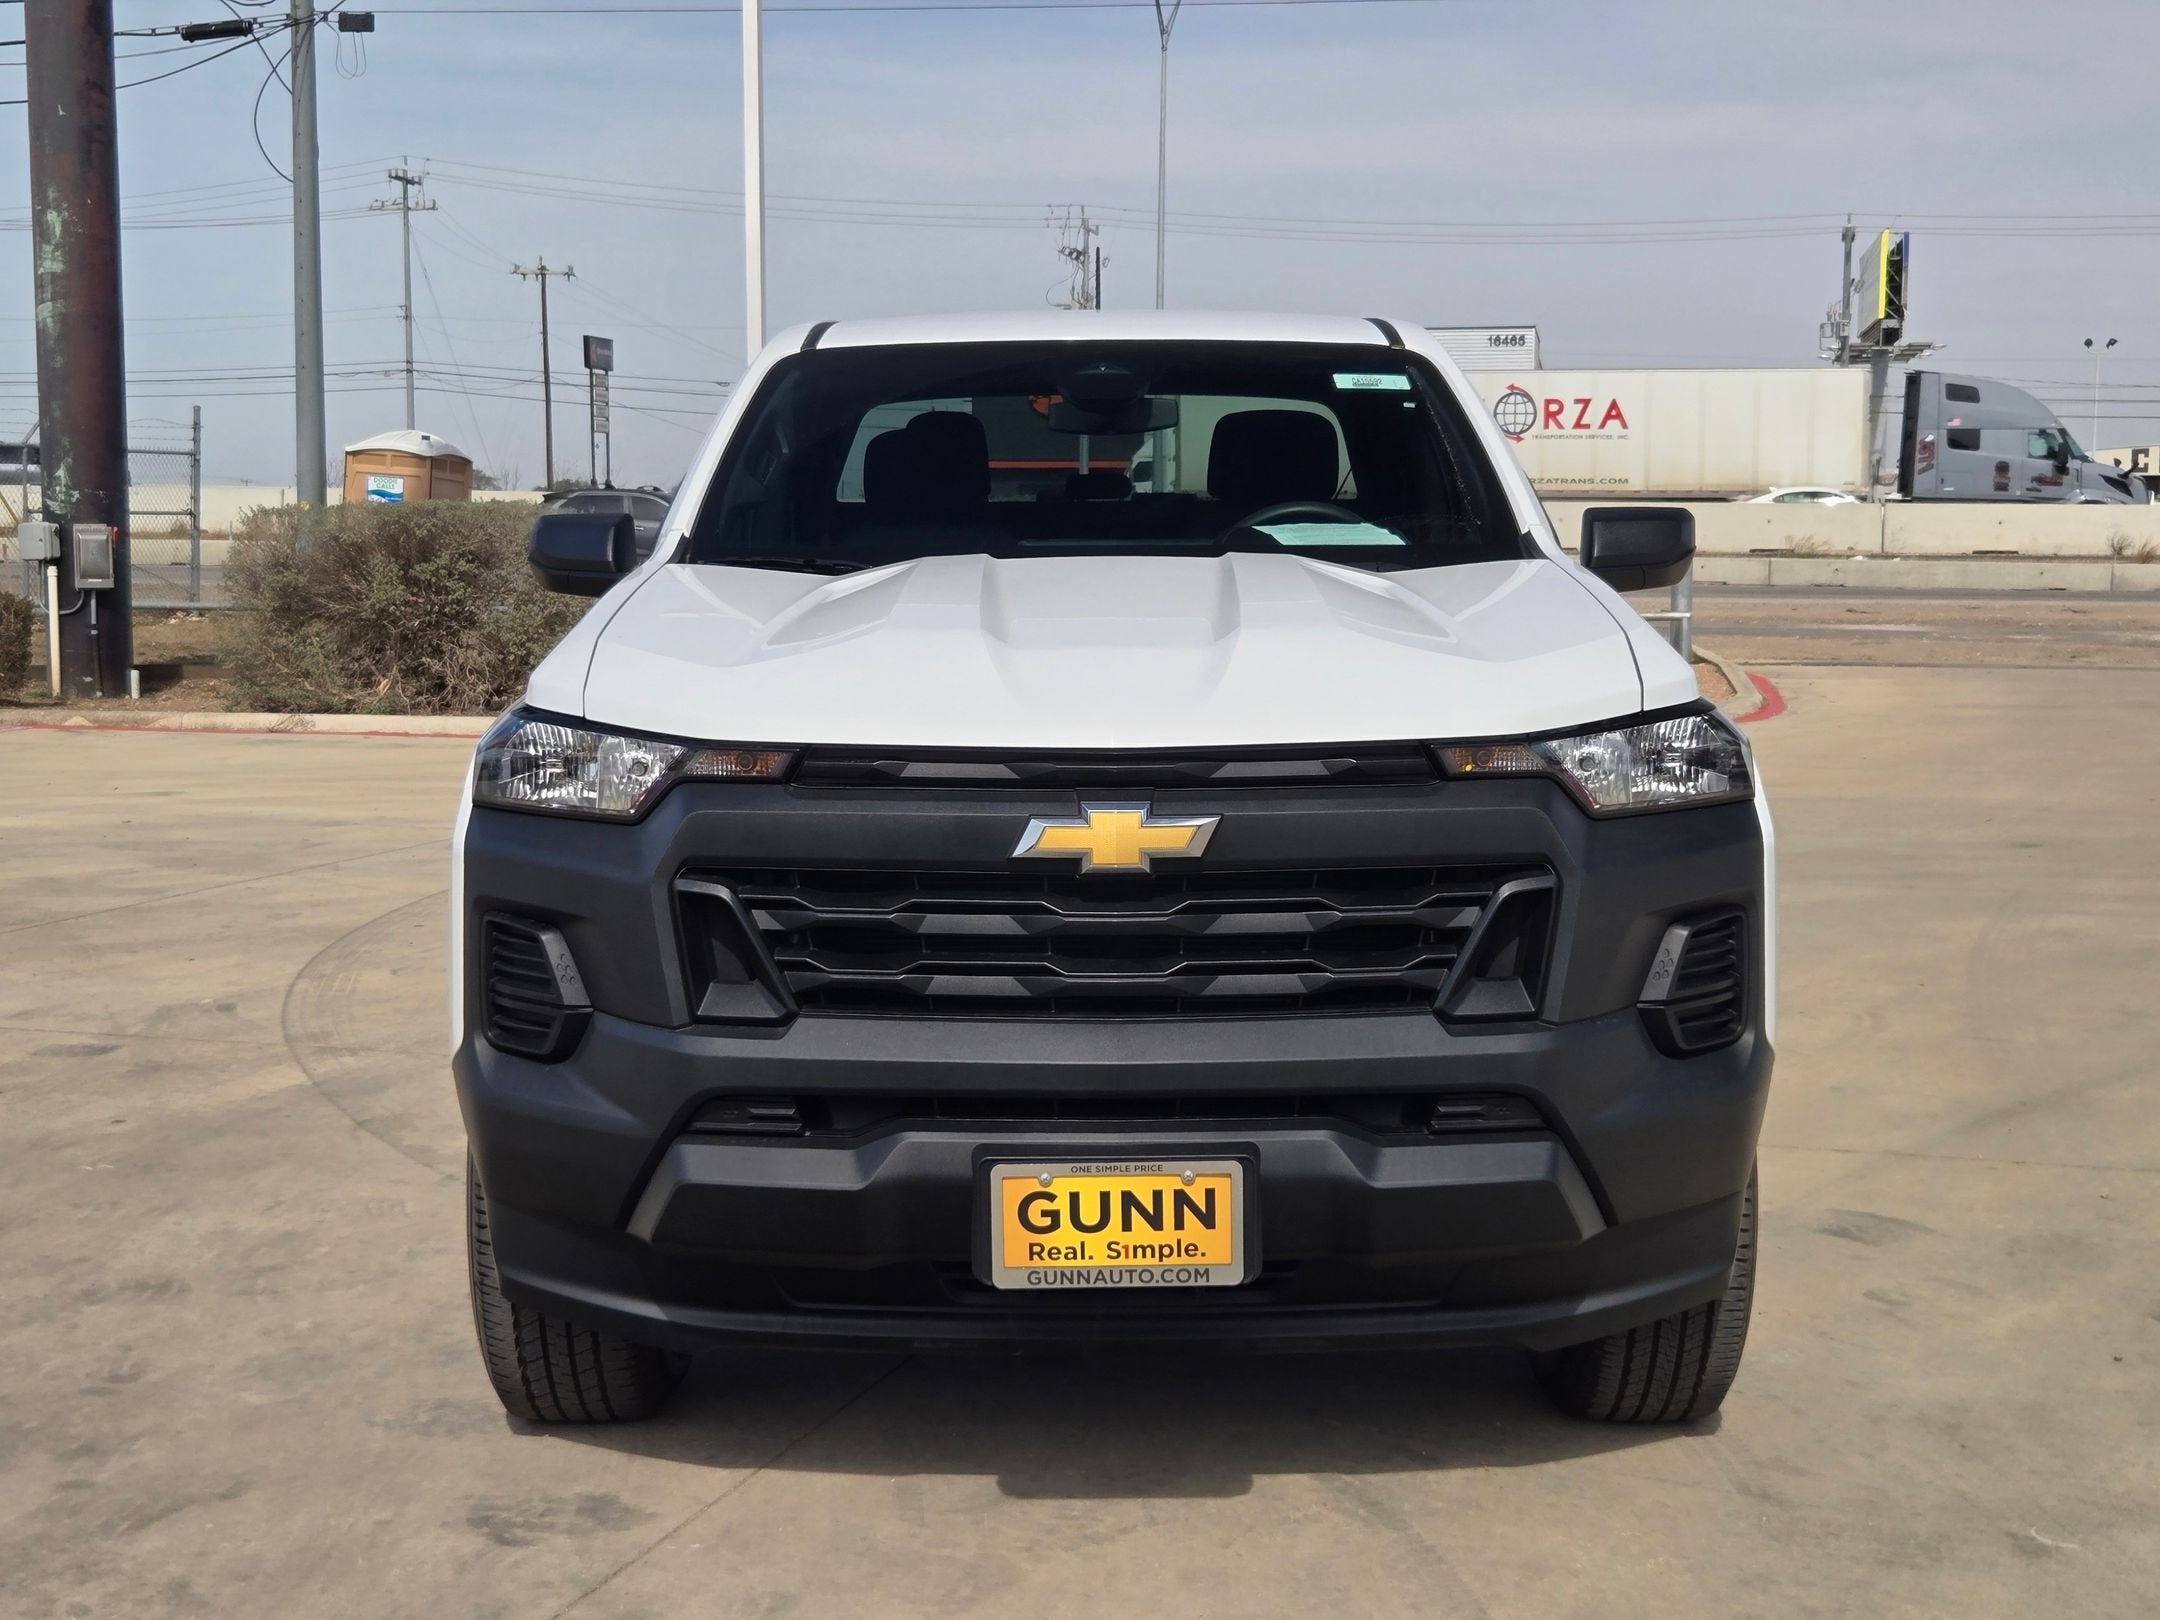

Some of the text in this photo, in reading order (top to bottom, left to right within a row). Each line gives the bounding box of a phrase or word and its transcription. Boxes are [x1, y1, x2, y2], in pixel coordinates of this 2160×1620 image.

[1070, 1164, 1164, 1174] ONE SIMPLE PRICE
[1017, 1187, 1217, 1236] GUNN
[1028, 1241, 1094, 1262] Real.
[1026, 1267, 1211, 1286] GUNNAUTO.COM
